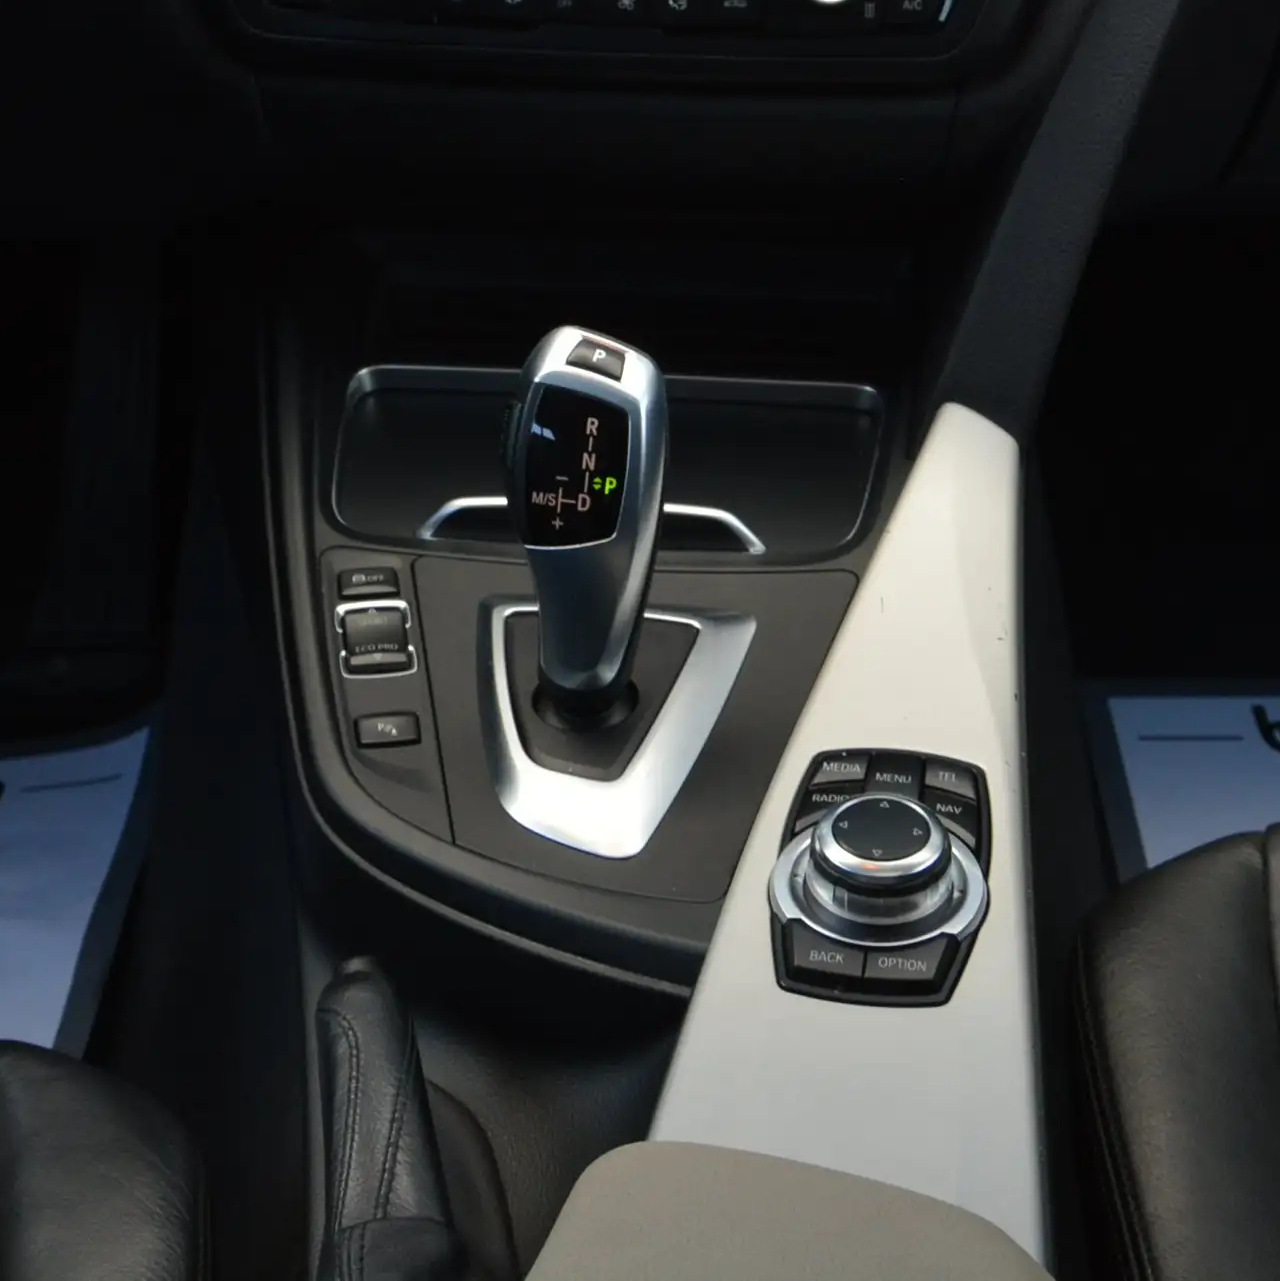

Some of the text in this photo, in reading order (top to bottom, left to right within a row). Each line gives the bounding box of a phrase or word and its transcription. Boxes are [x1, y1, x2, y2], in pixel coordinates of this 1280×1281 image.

[591, 348, 607, 362] P
[585, 416, 600, 437] R
[581, 452, 597, 472] N
[604, 476, 618, 495] P
[530, 490, 557, 507] M/S
[576, 492, 592, 513] D
[821, 761, 861, 773] MEDIA
[875, 772, 912, 784] MENU
[935, 802, 962, 815] NAV
[809, 950, 845, 965] BACK
[878, 957, 927, 972] OPTION
